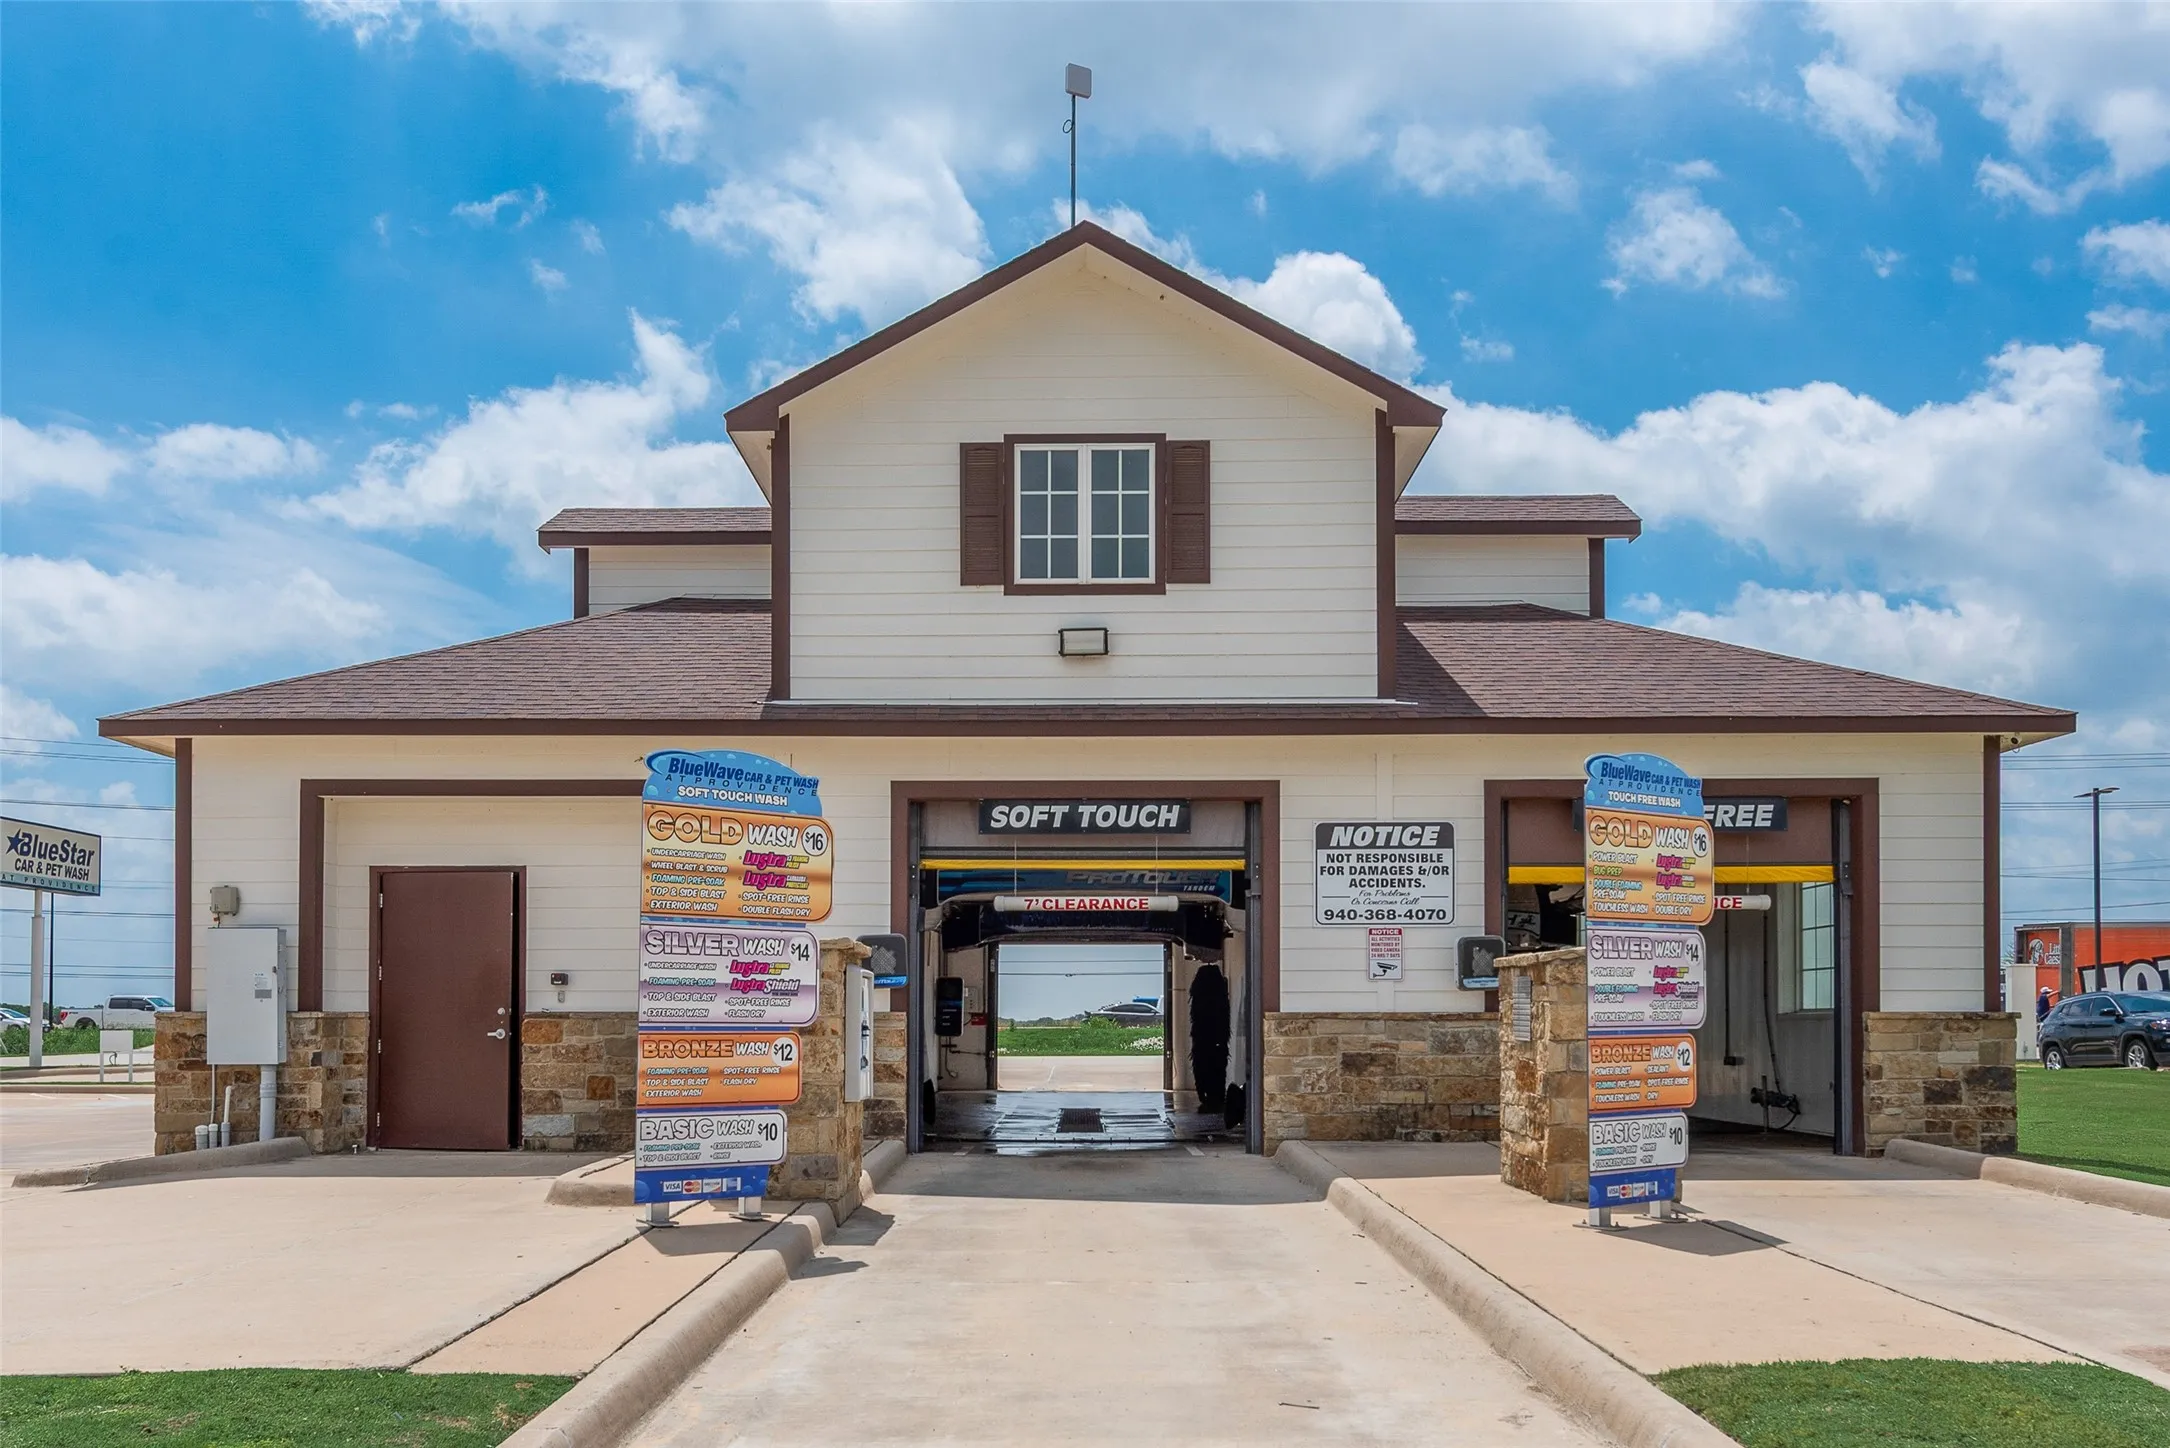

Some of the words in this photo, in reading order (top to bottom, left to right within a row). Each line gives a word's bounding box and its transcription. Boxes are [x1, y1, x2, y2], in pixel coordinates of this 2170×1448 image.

[668, 758, 744, 780] BlueWave
[745, 772, 763, 783] CAR
[765, 774, 772, 784] &
[775, 776, 791, 786] PET
[793, 777, 819, 788] WASH
[1601, 762, 1651, 783] BlueWave
[1652, 773, 1664, 785] CAR
[1665, 776, 1670, 785] &
[1671, 777, 1683, 786] PET
[1684, 778, 1700, 788] WASH
[695, 778, 817, 796] PROVIDENCE
[1619, 781, 1701, 796] PROVIDENCE
[678, 785, 709, 798] SOFT
[712, 789, 754, 802] TOUCH
[755, 793, 788, 806] WASH
[1608, 791, 1636, 801] TOUCH
[1638, 794, 1658, 805] FREE
[1659, 797, 1681, 808] WASH
[991, 805, 1069, 828] SOFT
[1078, 805, 1180, 828] TOUCH
[647, 810, 743, 845] GOLD
[748, 823, 799, 848] WASH
[805, 832, 823, 850] $16
[1330, 826, 1440, 846] NOTICE
[1589, 815, 1652, 848] GOLD
[1655, 826, 1689, 849] WASH
[1694, 834, 1706, 851] $16
[19, 832, 95, 866] BlueStar
[651, 848, 705, 859] UNDERCARRIAGE
[706, 852, 726, 860] WASH
[743, 850, 787, 870] Lustra
[1327, 854, 1352, 863] NOT
[1357, 854, 1443, 863] RESPONSIBLE
[1593, 851, 1618, 862] POWER
[1619, 853, 1638, 864] BLAST
[15, 858, 34, 873] CAR
[36, 861, 43, 873] &
[46, 863, 63, 877] PET
[64, 865, 89, 881] WASH
[651, 861, 673, 869] WHEEL
[675, 862, 697, 871] BLAST
[699, 864, 704, 872] &
[706, 865, 728, 874] SCRUB
[1320, 866, 1344, 875] FOR
[1349, 866, 1413, 875] DAMAGES
[1418, 866, 1449, 876] &/OR
[1593, 865, 1606, 875] BUG
[1607, 866, 1622, 876] PREP
[24, 877, 95, 892] PROVIDENCE
[652, 873, 685, 884] FOAMING
[687, 875, 725, 886] PRE-SOAK
[743, 871, 787, 890] Lustra
[1349, 878, 1425, 888] ACCIDENTS.
[1594, 878, 1616, 889] DOUBLE
[1617, 880, 1642, 890] FOAMING
[650, 886, 669, 896] TOP
[670, 888, 676, 896] &
[679, 888, 698, 897] SIDE
[700, 889, 726, 899] BLAST
[742, 892, 786, 903] SPOT-FREE
[788, 894, 810, 904] RINSE
[1655, 892, 1671, 903] SPOT
[1689, 894, 1705, 904] RINSE
[650, 900, 691, 910] EXTERIOR
[693, 902, 718, 911] WASH
[742, 905, 770, 914] DOUBLE
[772, 907, 794, 916] FLASH
[796, 908, 811, 916] DRY
[1042, 898, 1149, 910] CLEARANCE
[1593, 901, 1628, 913] TOUCHLESS
[1630, 903, 1648, 914] WASH
[1655, 905, 1679, 914] DOUBLE
[1680, 906, 1693, 915] DRY
[1324, 909, 1447, 920] 940-368-4070
[645, 930, 739, 956] SILVER
[743, 937, 785, 956] WASH
[791, 943, 809, 961] $14
[1590, 935, 1653, 960] SILVER
[1655, 940, 1683, 958] WASH
[1686, 944, 1699, 961] $14
[648, 961, 697, 970] UNDERCARRIAGE
[729, 959, 770, 977] Lustra
[649, 977, 680, 986] FOAMING
[681, 977, 716, 986] PRE-SOAK
[647, 992, 664, 1001] TOP
[665, 992, 672, 1001] &
[673, 992, 691, 1001] SIDE
[692, 992, 717, 1002] BLAST
[770, 998, 791, 1007] RINSE
[647, 1008, 685, 1017] EXTERIOR
[686, 1009, 709, 1018] WASH
[728, 1009, 749, 1018] FLASH
[750, 1009, 766, 1018] DRY
[643, 1039, 734, 1059] BRONZE
[736, 1041, 769, 1056] WASH
[773, 1043, 793, 1061] $12
[1591, 1044, 1651, 1063] BRONZE
[1652, 1045, 1675, 1060] WASH
[1677, 1049, 1690, 1066] $12
[676, 1067, 709, 1075] PRE-SOAK
[761, 1066, 781, 1074] RINSE
[646, 1078, 661, 1086] TOP
[662, 1078, 668, 1086] &
[670, 1078, 685, 1086] SIDE
[640, 1118, 714, 1140] BASIC
[717, 1119, 755, 1136] WASH
[758, 1123, 778, 1141] $10
[1592, 1122, 1640, 1145] BASIC
[1641, 1123, 1667, 1139] WASH
[1670, 1127, 1683, 1145] $10
